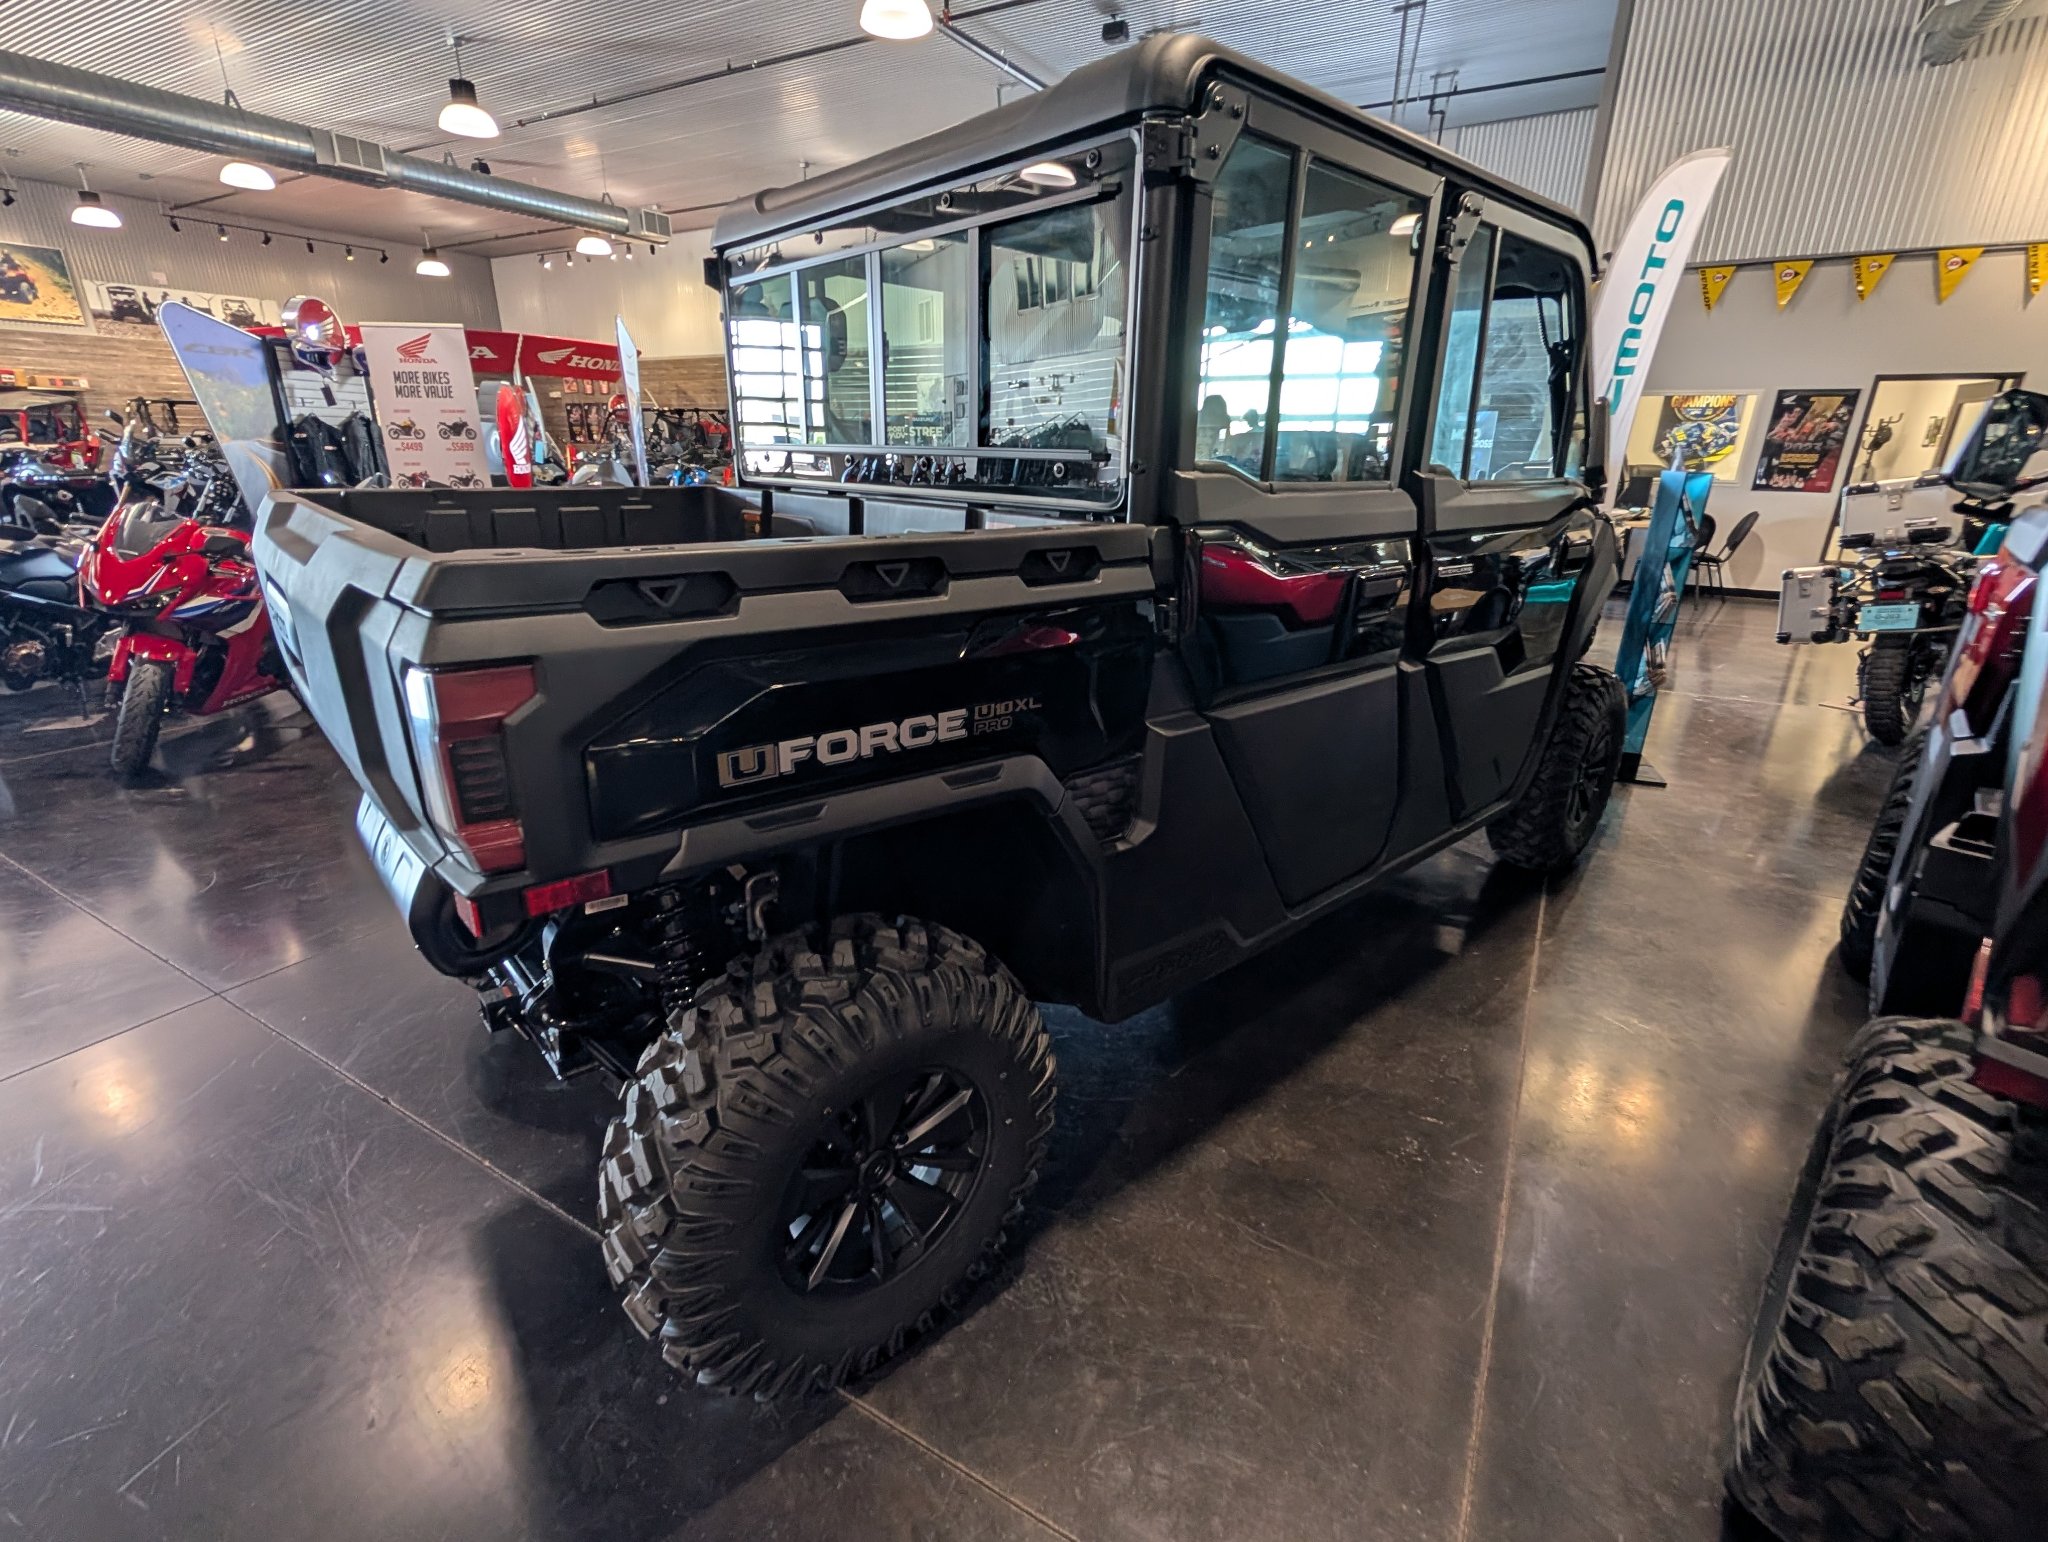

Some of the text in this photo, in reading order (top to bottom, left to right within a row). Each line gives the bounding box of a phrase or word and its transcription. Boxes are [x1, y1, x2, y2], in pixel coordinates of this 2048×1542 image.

[1700, 270, 1711, 310] DUNLOP
[393, 371, 450, 385] MORE BIKES
[395, 385, 454, 399] MORE VALUE
[1671, 395, 1736, 408] CHAMPIONS
[909, 426, 944, 438] STREE
[974, 716, 1012, 735] PRO
